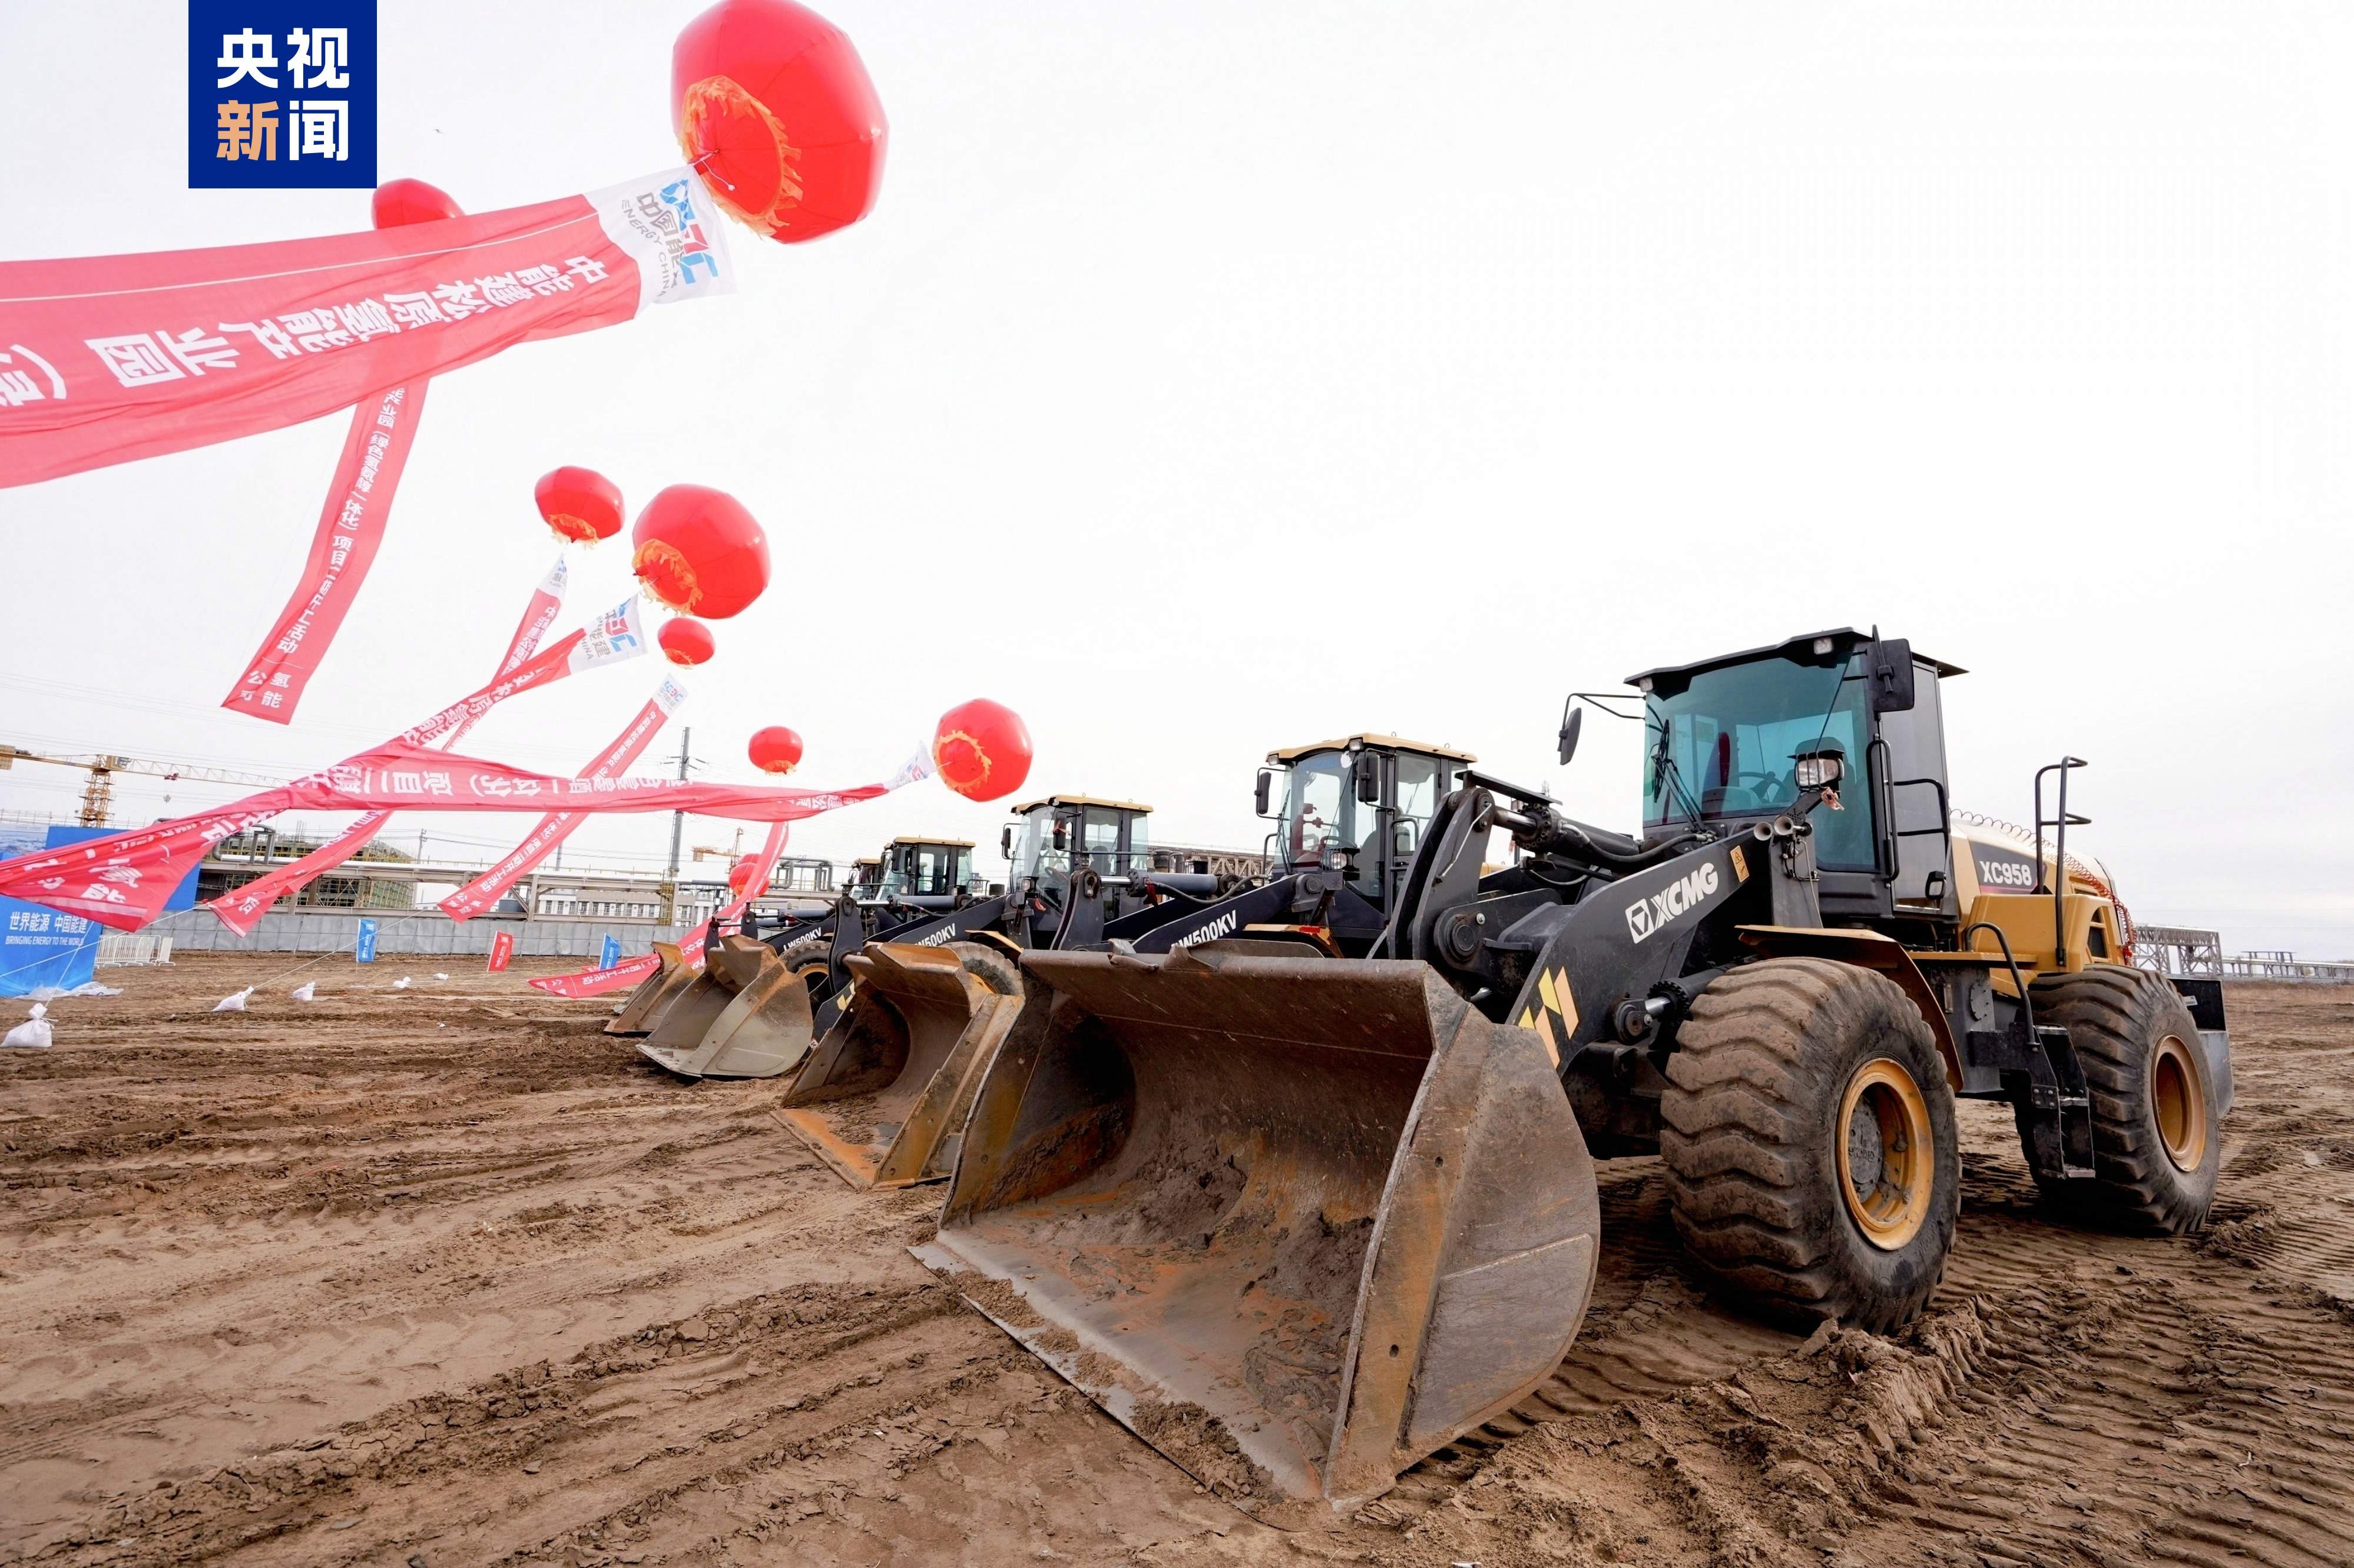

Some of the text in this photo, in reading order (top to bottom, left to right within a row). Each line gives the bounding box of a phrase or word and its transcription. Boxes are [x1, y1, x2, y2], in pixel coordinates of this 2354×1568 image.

[621, 198, 663, 246] ENERGY
[1979, 861, 2032, 886] XC958
[1650, 862, 1719, 929] XCMG
[9, 912, 89, 934] 世界能源 中国能建
[1170, 909, 1236, 947] W500KV
[5, 936, 84, 946] BRINGING ENERGY TO THE WORLD
